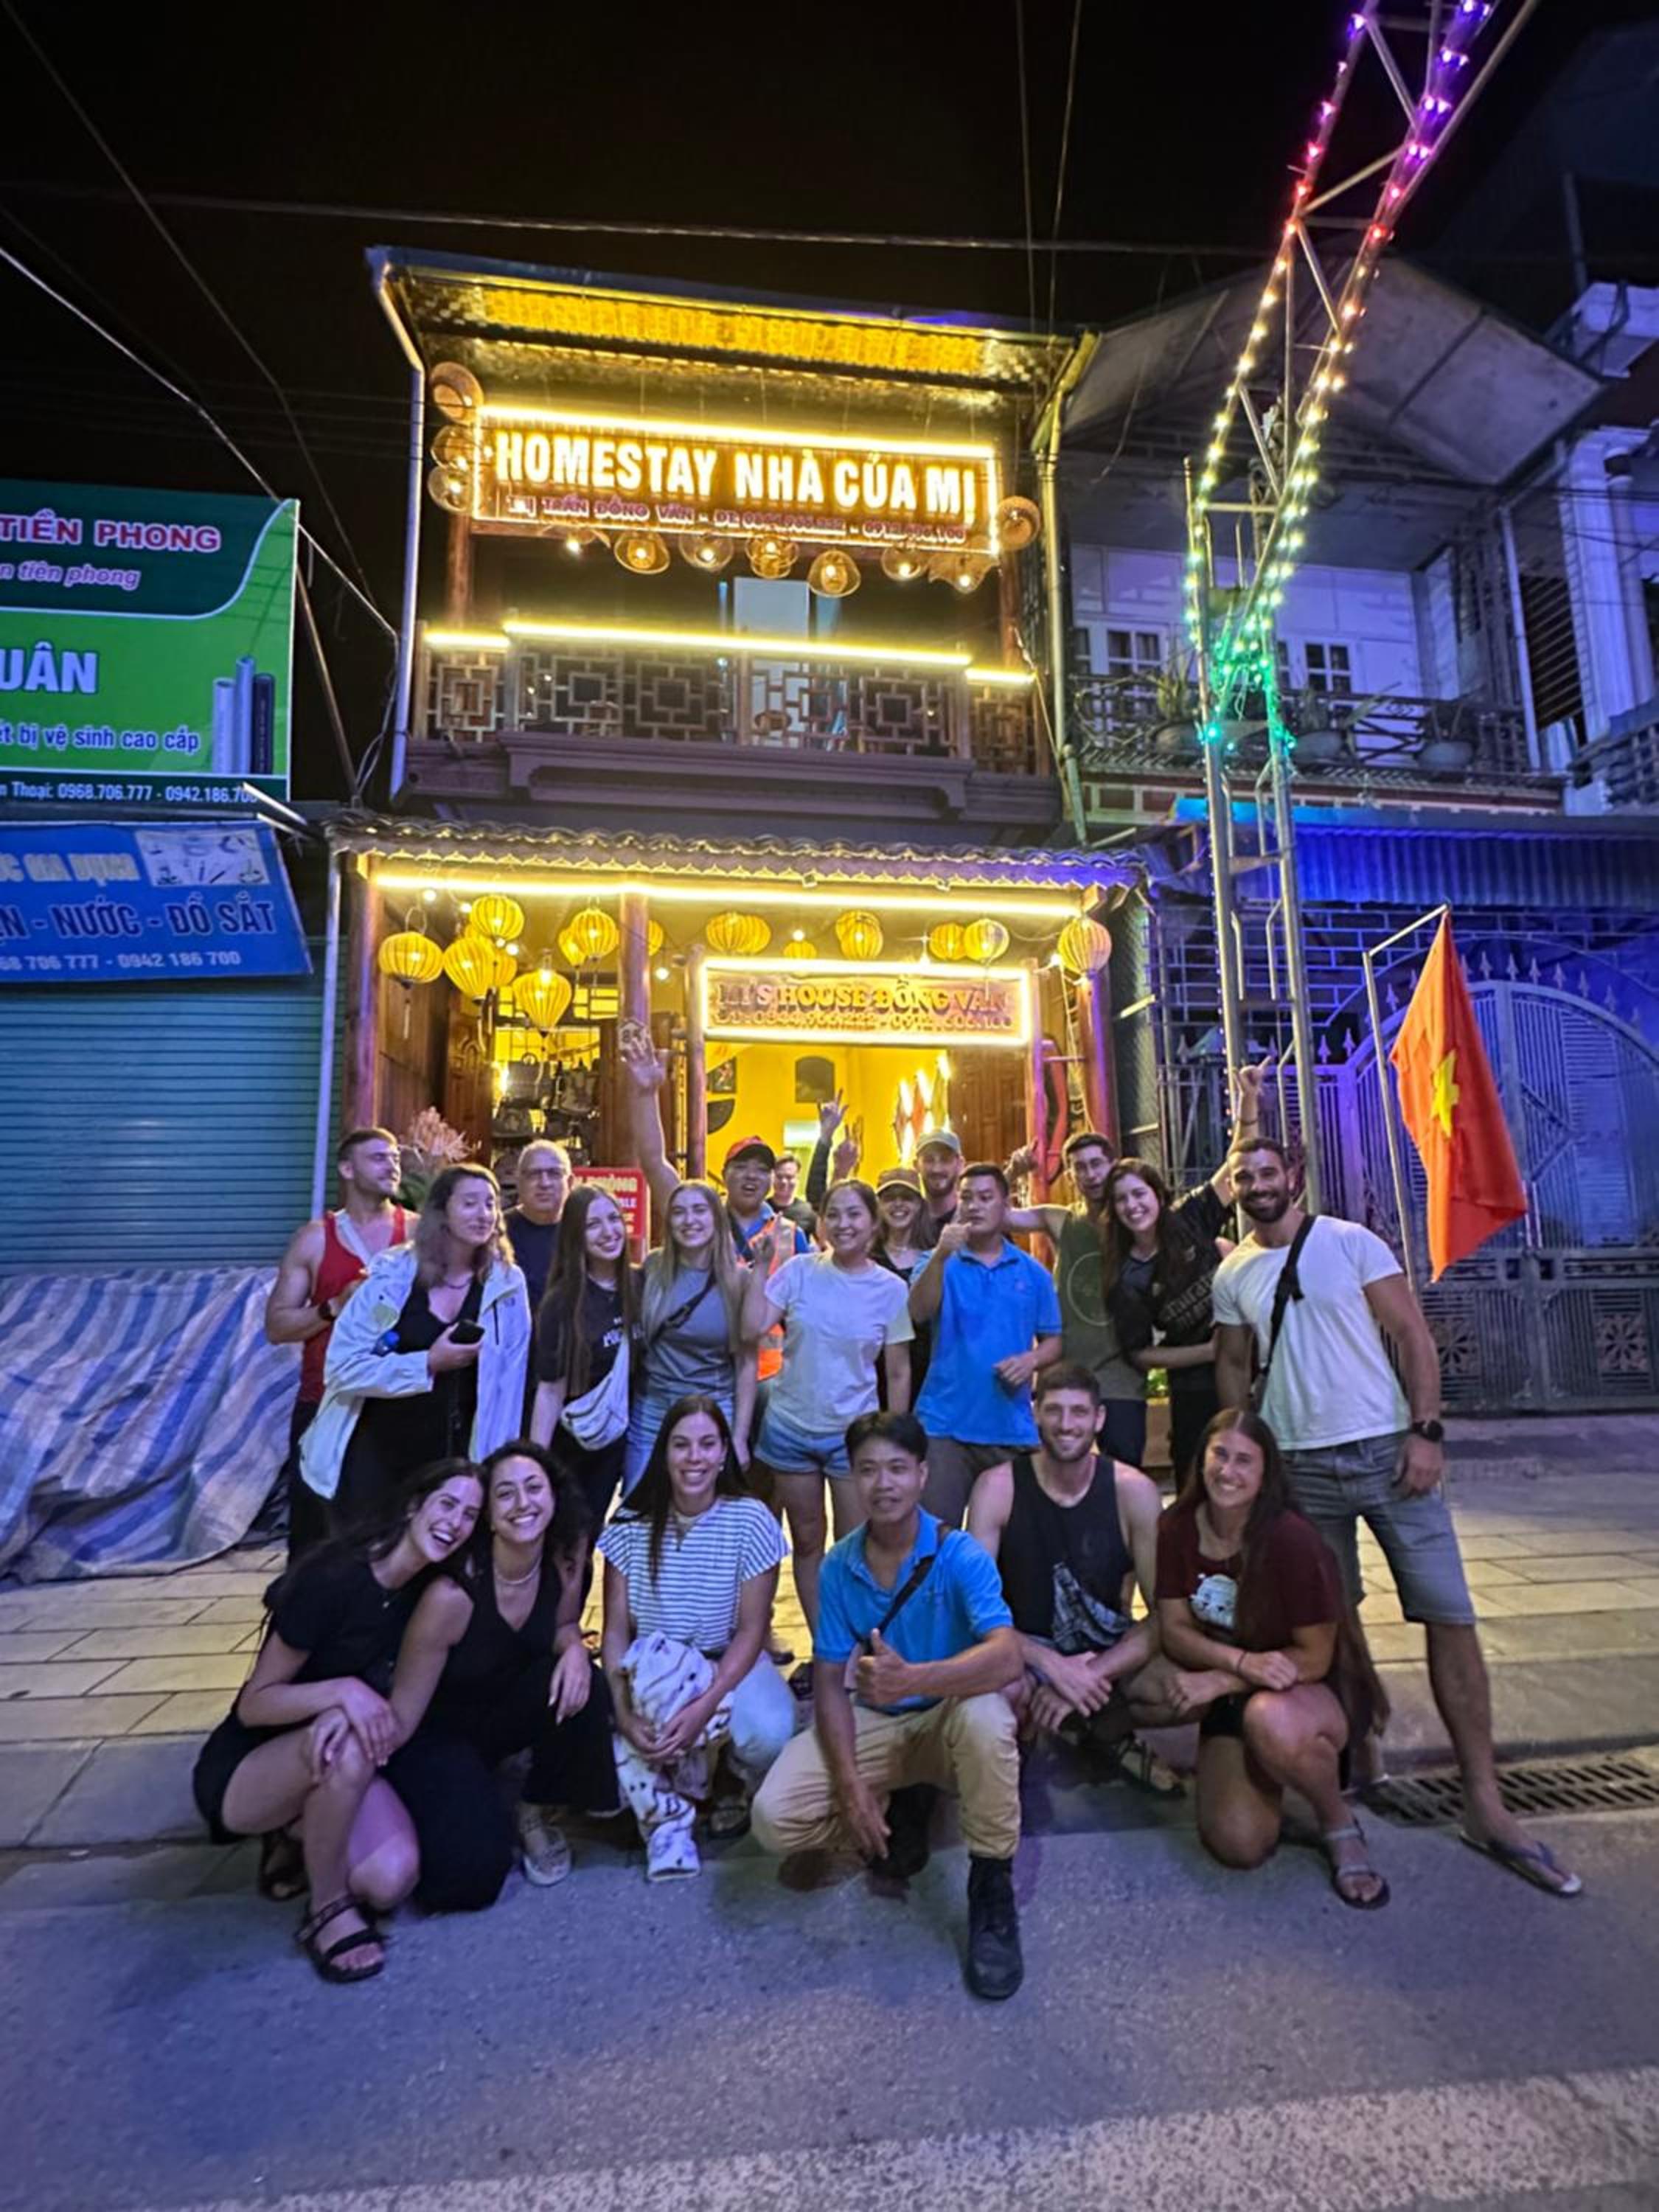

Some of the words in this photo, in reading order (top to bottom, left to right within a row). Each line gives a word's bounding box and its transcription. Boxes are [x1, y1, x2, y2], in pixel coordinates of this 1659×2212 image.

[495, 430, 717, 497] HOMESTAY
[734, 448, 824, 504] NHÀ
[925, 466, 976, 529] MỊ
[94, 520, 220, 552] PHONG
[63, 563, 141, 591] phong
[73, 725, 116, 749] sinh
[120, 730, 159, 751] cao
[57, 782, 153, 801] 0968.706.777
[49, 894, 142, 937] NƯỚC
[217, 890, 276, 935] SẮT
[776, 983, 870, 1009] HOUSE
